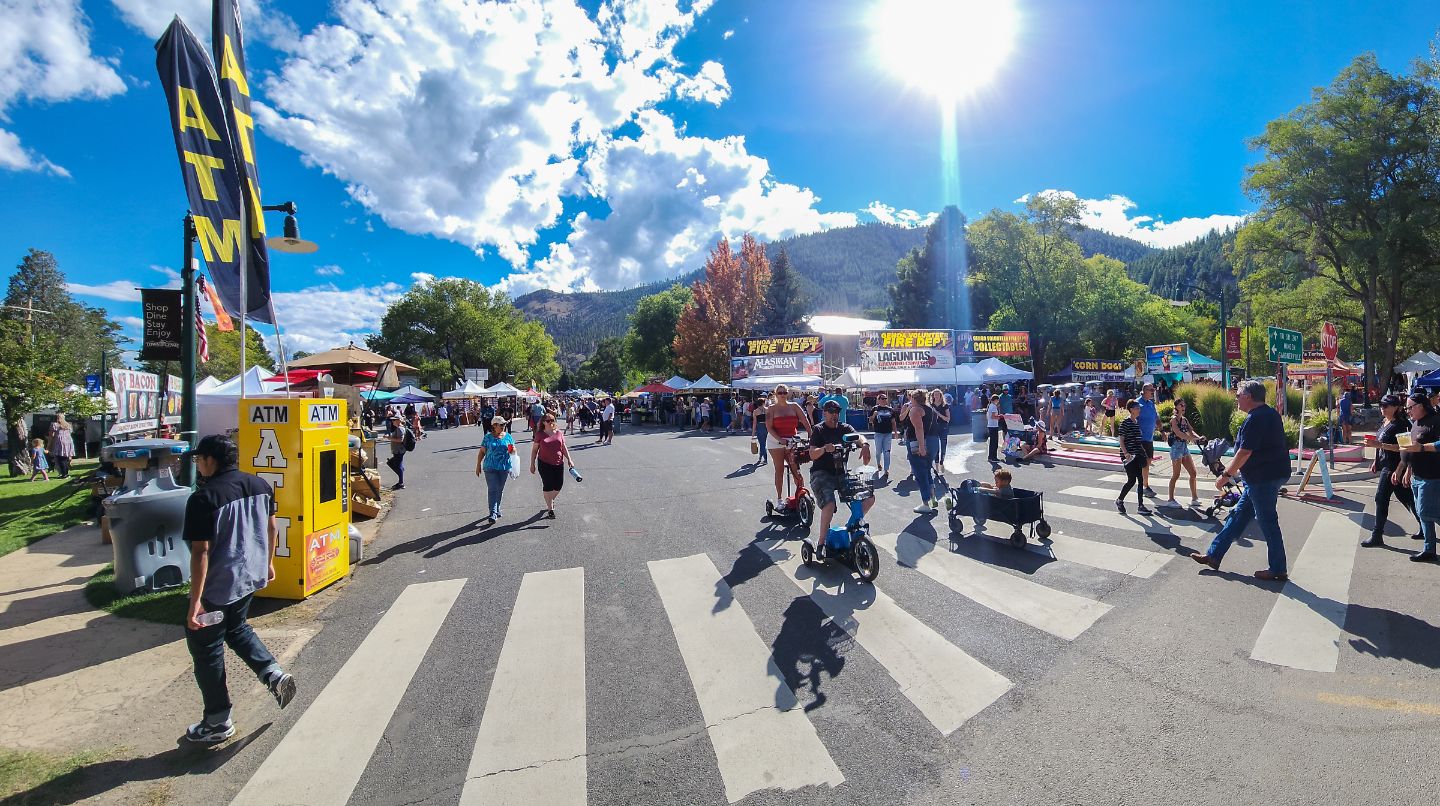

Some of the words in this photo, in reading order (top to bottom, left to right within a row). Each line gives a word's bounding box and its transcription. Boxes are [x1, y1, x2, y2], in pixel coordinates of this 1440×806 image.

[177, 85, 241, 263] ATM
[146, 303, 169, 312] Shop
[146, 312, 167, 320] Dine
[146, 320, 166, 330] Stay
[147, 329, 171, 338] Enjoy
[883, 338, 913, 348] FIRE
[916, 338, 948, 347] DEPT
[973, 342, 1027, 352] COLLECTABLES
[1322, 333, 1337, 350] STOP
[748, 343, 777, 355] FIRE
[782, 342, 818, 353] DEPT
[878, 351, 931, 362] LAGUNITAS
[753, 357, 798, 371] ALASKAN
[1101, 362, 1122, 370] DOGS
[129, 373, 156, 389] BACON
[252, 406, 288, 423] ATM
[310, 405, 338, 422] ATM
[310, 527, 341, 552] ATM
